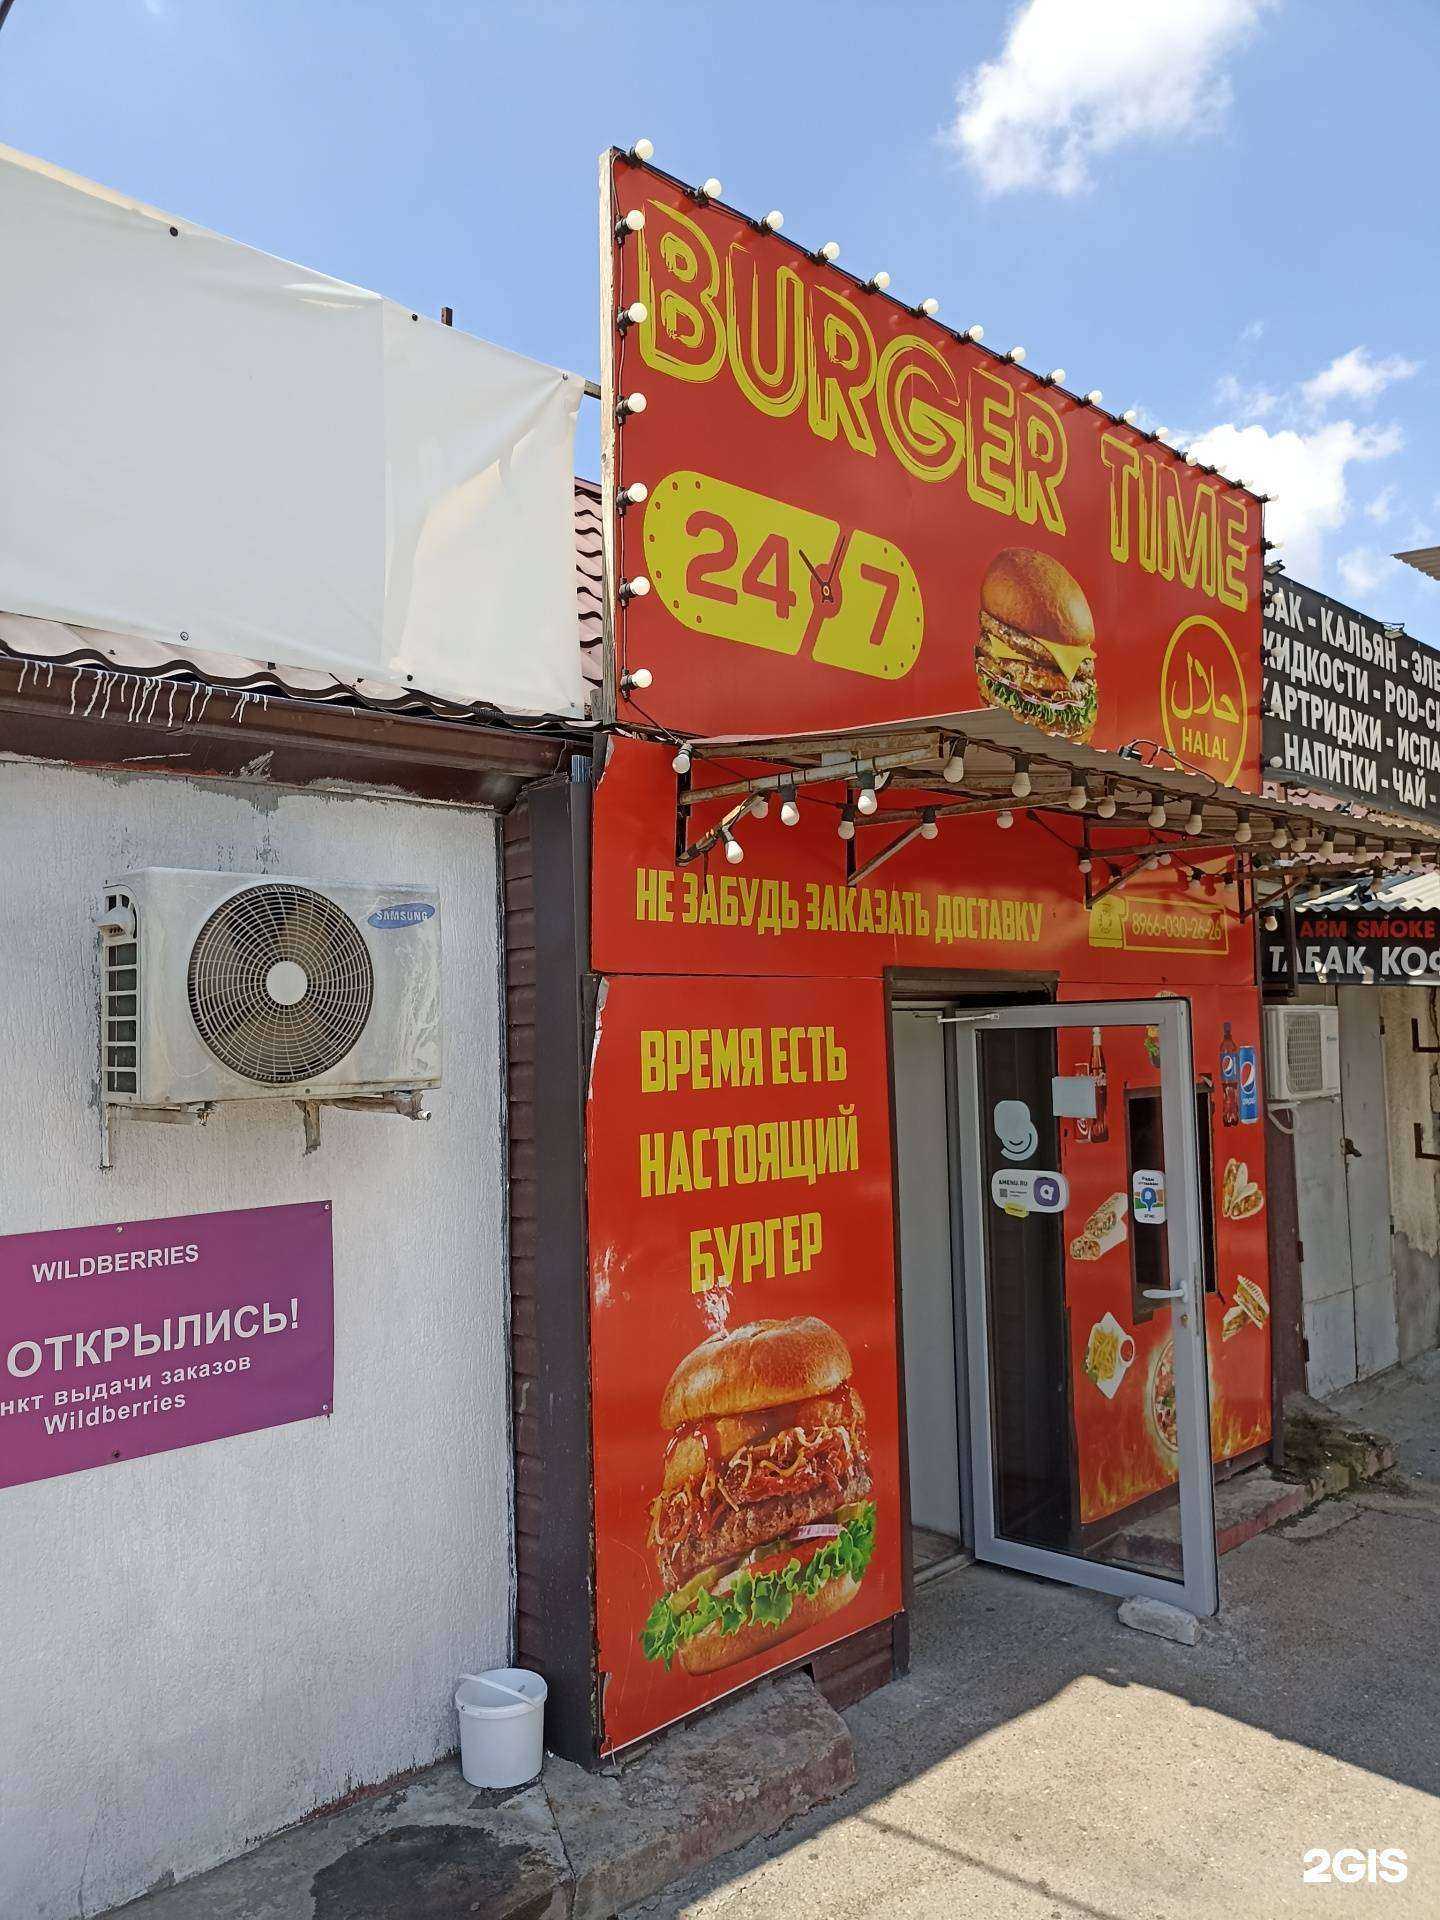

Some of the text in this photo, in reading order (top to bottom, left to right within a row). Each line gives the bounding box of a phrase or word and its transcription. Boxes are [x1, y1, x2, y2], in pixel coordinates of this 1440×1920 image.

[638, 199, 1249, 612] BURGER TIME
[1320, 607, 1398, 674] КАЛЬЯН
[1171, 651, 1240, 724] حلال
[1182, 727, 1229, 762] HALAL
[1284, 732, 1377, 795] НАПИТКИ
[1392, 768, 1426, 809] ЧАЙ
[376, 910, 428, 921] SAMSUNG
[636, 867, 1043, 944] НЕ ЗАБУДЬ ЗАКАЗАТЬ ДОСТАВКУ
[1300, 919, 1436, 938] ARM SMOKE
[640, 1026, 847, 1093] ВРЕМЯ ЕСТЬ
[639, 1103, 859, 1198] НАСТОЯЩИЙ
[32, 1244, 200, 1283] WILDBERRIES
[690, 1211, 823, 1294] БУРГЕР
[7, 1298, 299, 1378] ОТКРЫЛИСЬ!
[44, 1393, 187, 1435] Wildberries
[54, 1374, 152, 1406] выдачи
[161, 1356, 251, 1386] заказов
